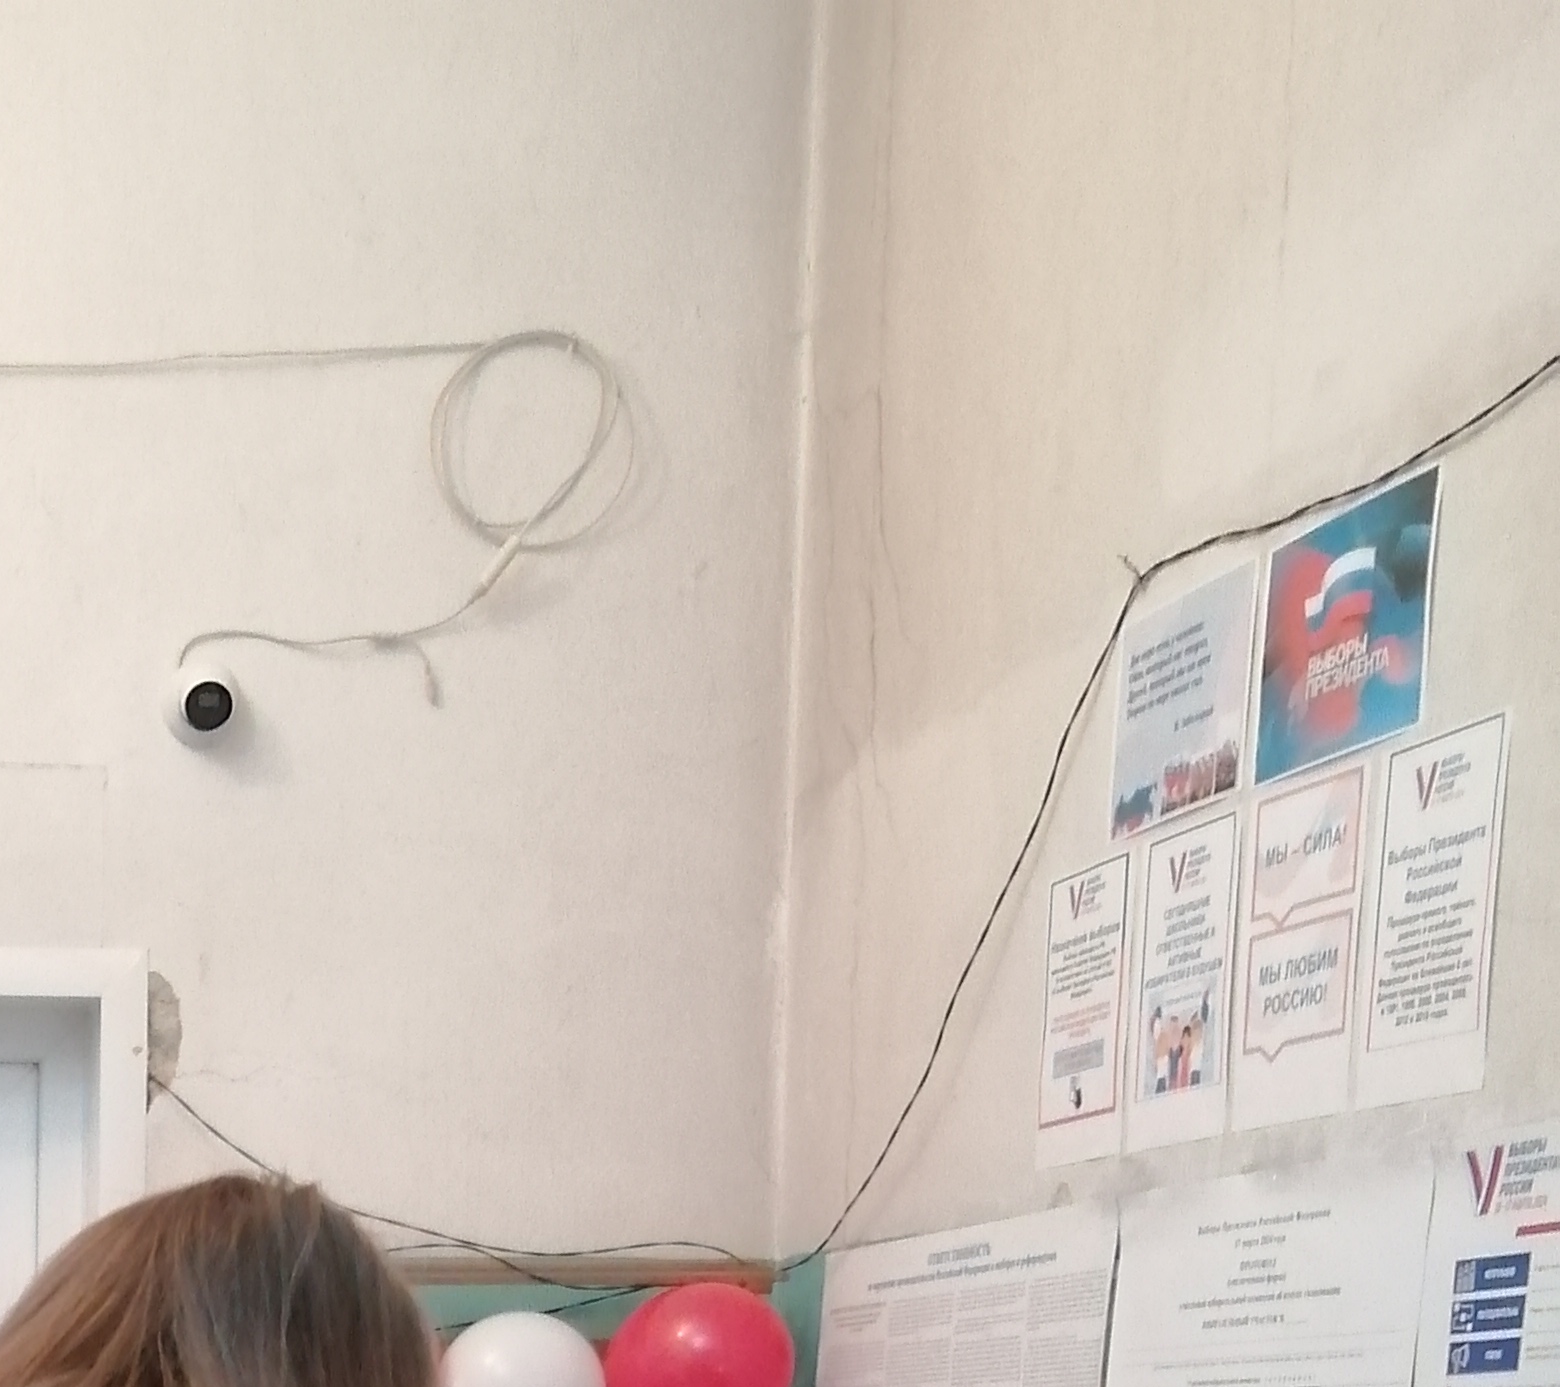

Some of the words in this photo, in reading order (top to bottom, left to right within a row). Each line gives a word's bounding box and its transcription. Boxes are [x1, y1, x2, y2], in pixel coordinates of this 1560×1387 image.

[1306, 647, 1389, 700] ПРЕЗИДЕНТА
[1308, 632, 1368, 677] ВЫБОРЫ
[1265, 843, 1288, 868] МЫ
[1303, 824, 1347, 856] СИЛА!
[1388, 845, 1427, 866] Выборы
[1428, 825, 1487, 853] Президента
[1259, 964, 1281, 987] МЫ
[1284, 948, 1339, 981] ЛЮБИМ
[1263, 983, 1327, 1017] РОССИЮ!
